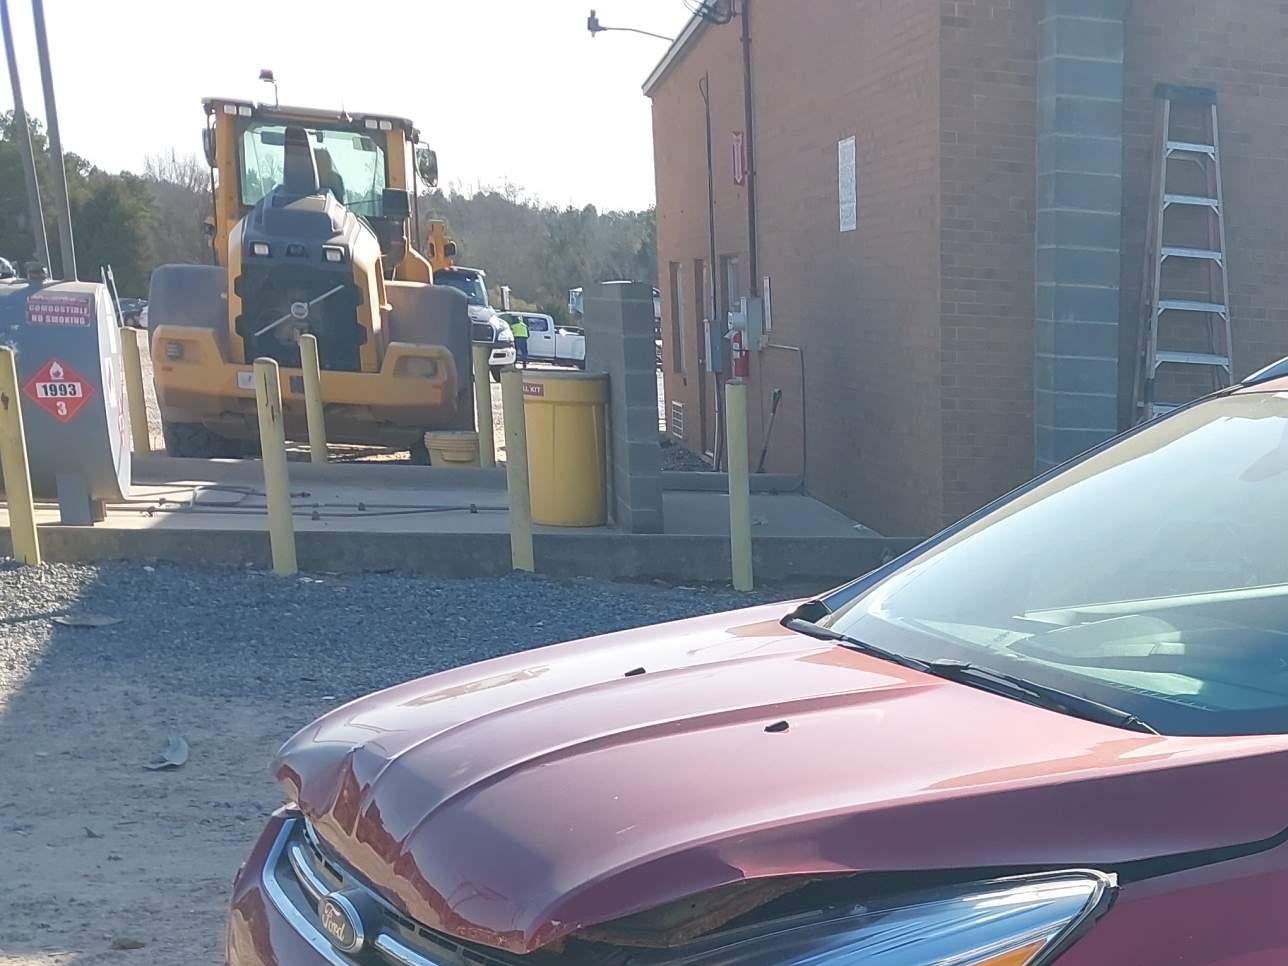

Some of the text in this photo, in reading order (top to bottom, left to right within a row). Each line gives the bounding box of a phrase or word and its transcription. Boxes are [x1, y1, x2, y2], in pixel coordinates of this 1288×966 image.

[29, 304, 88, 315] COMBUSTIBLE
[45, 315, 86, 325] SMOKING
[41, 383, 77, 397] 1993
[56, 400, 68, 416] 3
[321, 902, 346, 942] Ford
